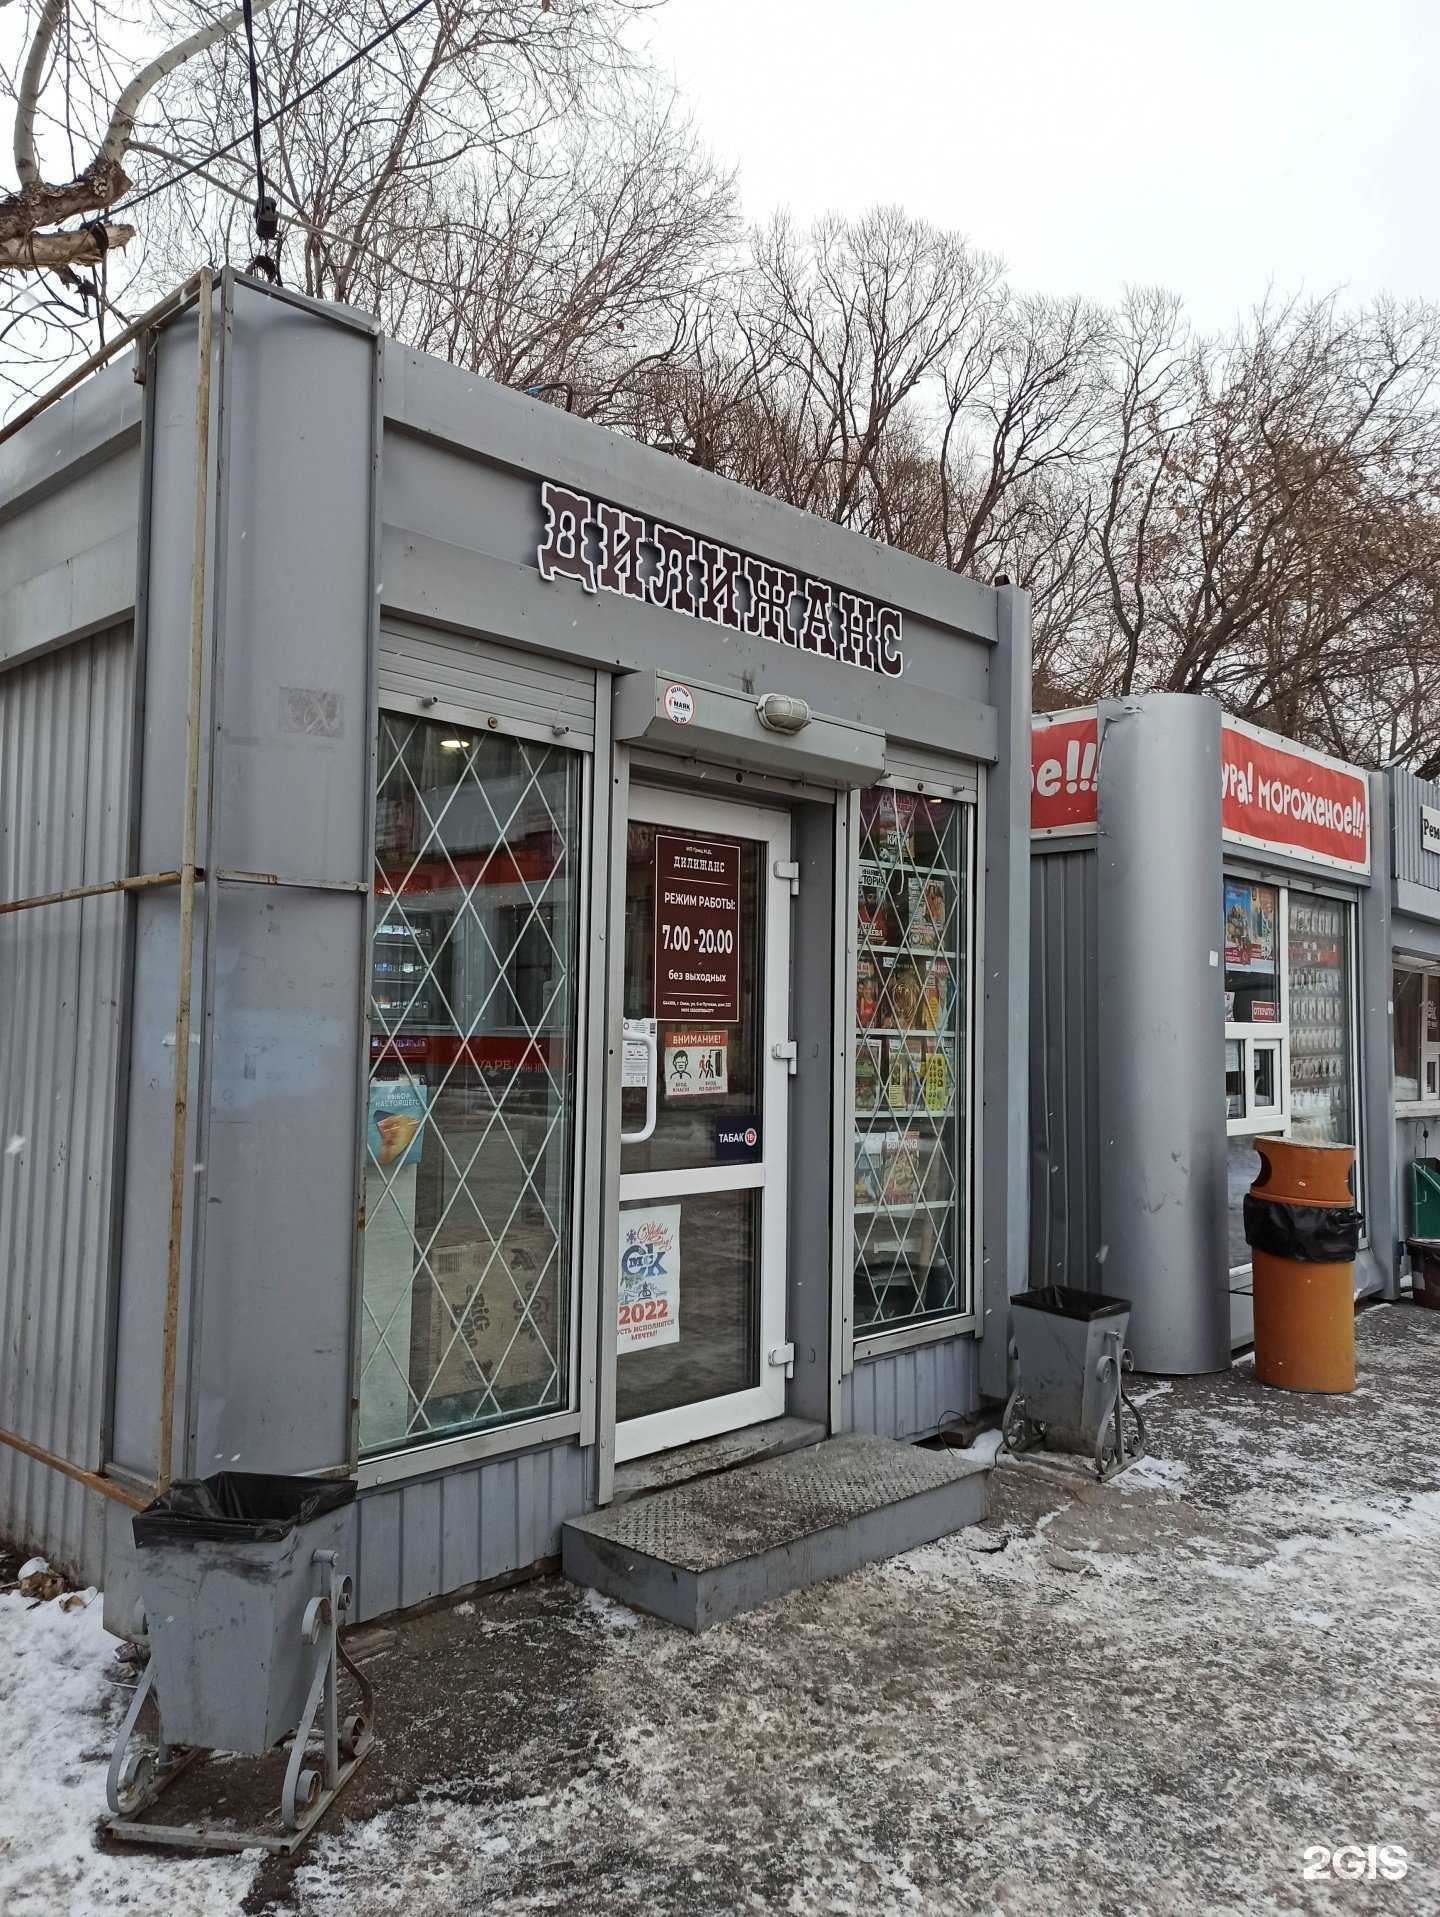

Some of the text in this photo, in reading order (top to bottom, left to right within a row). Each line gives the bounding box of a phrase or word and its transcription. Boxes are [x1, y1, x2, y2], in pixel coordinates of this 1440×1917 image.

[537, 481, 904, 679] ДИЛИЖАНС
[673, 855, 725, 873] ДИЛИЖАНС
[664, 891, 736, 910] РЕЖИМ РАБОТЫ:
[662, 924, 691, 952] 7.00
[668, 969, 727, 983] без выходных
[1253, 1007, 1275, 1017] ОТКРЫТО
[672, 1034, 721, 1045] ВНИМАНИЕ!
[719, 1133, 744, 1143] ТАБАК
[618, 1299, 669, 1326] 2022
[616, 1326, 633, 1337] УСТЬ
